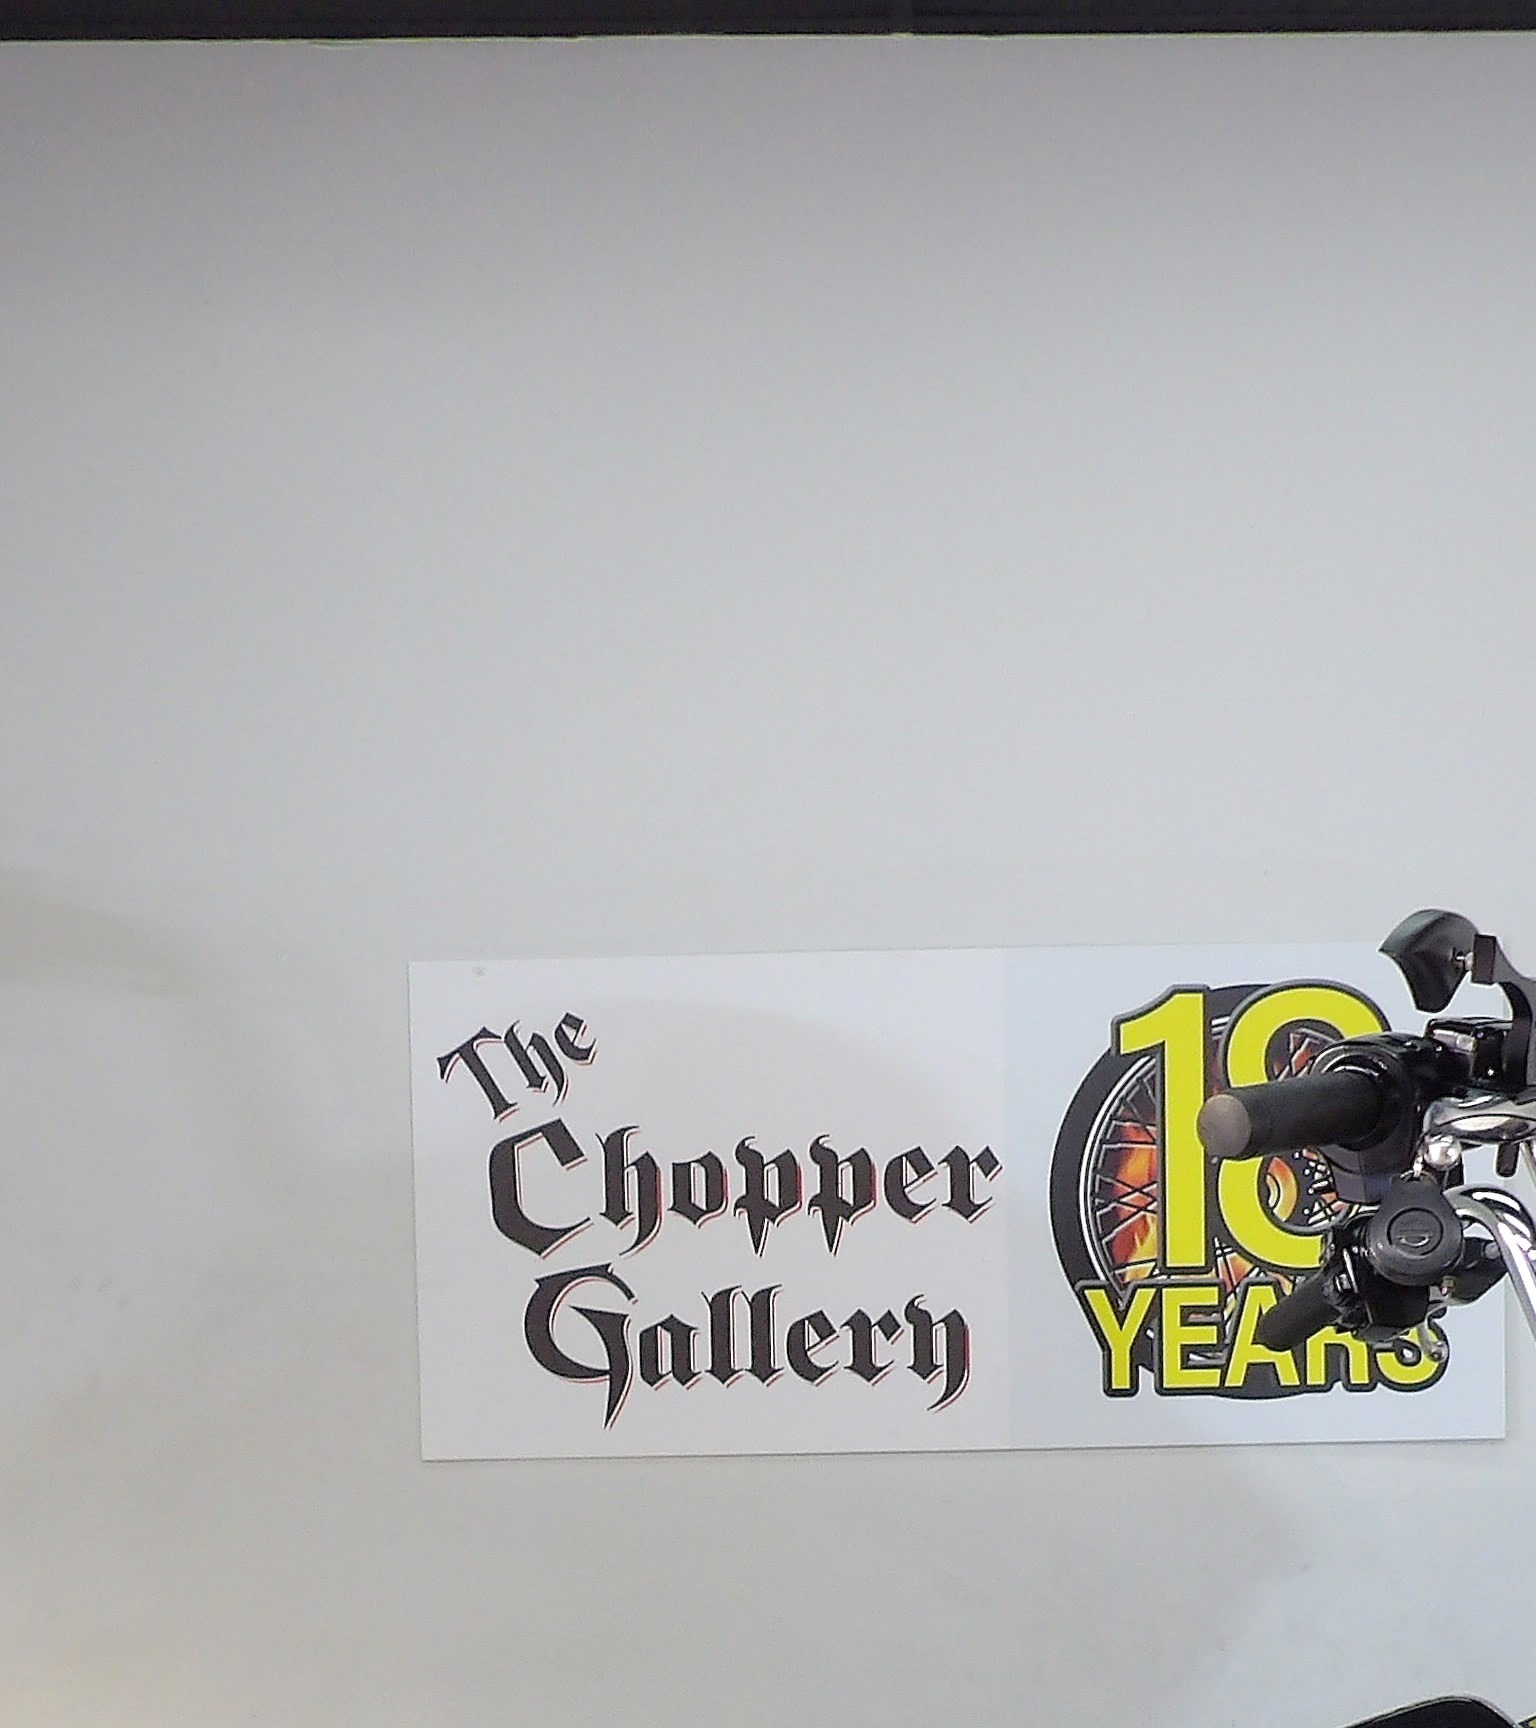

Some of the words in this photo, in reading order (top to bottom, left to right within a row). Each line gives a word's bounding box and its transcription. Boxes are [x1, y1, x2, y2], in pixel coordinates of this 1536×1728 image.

[436, 1010, 598, 1122] The
[489, 1117, 1003, 1258] Chopper
[524, 1263, 971, 1430] Gallery
